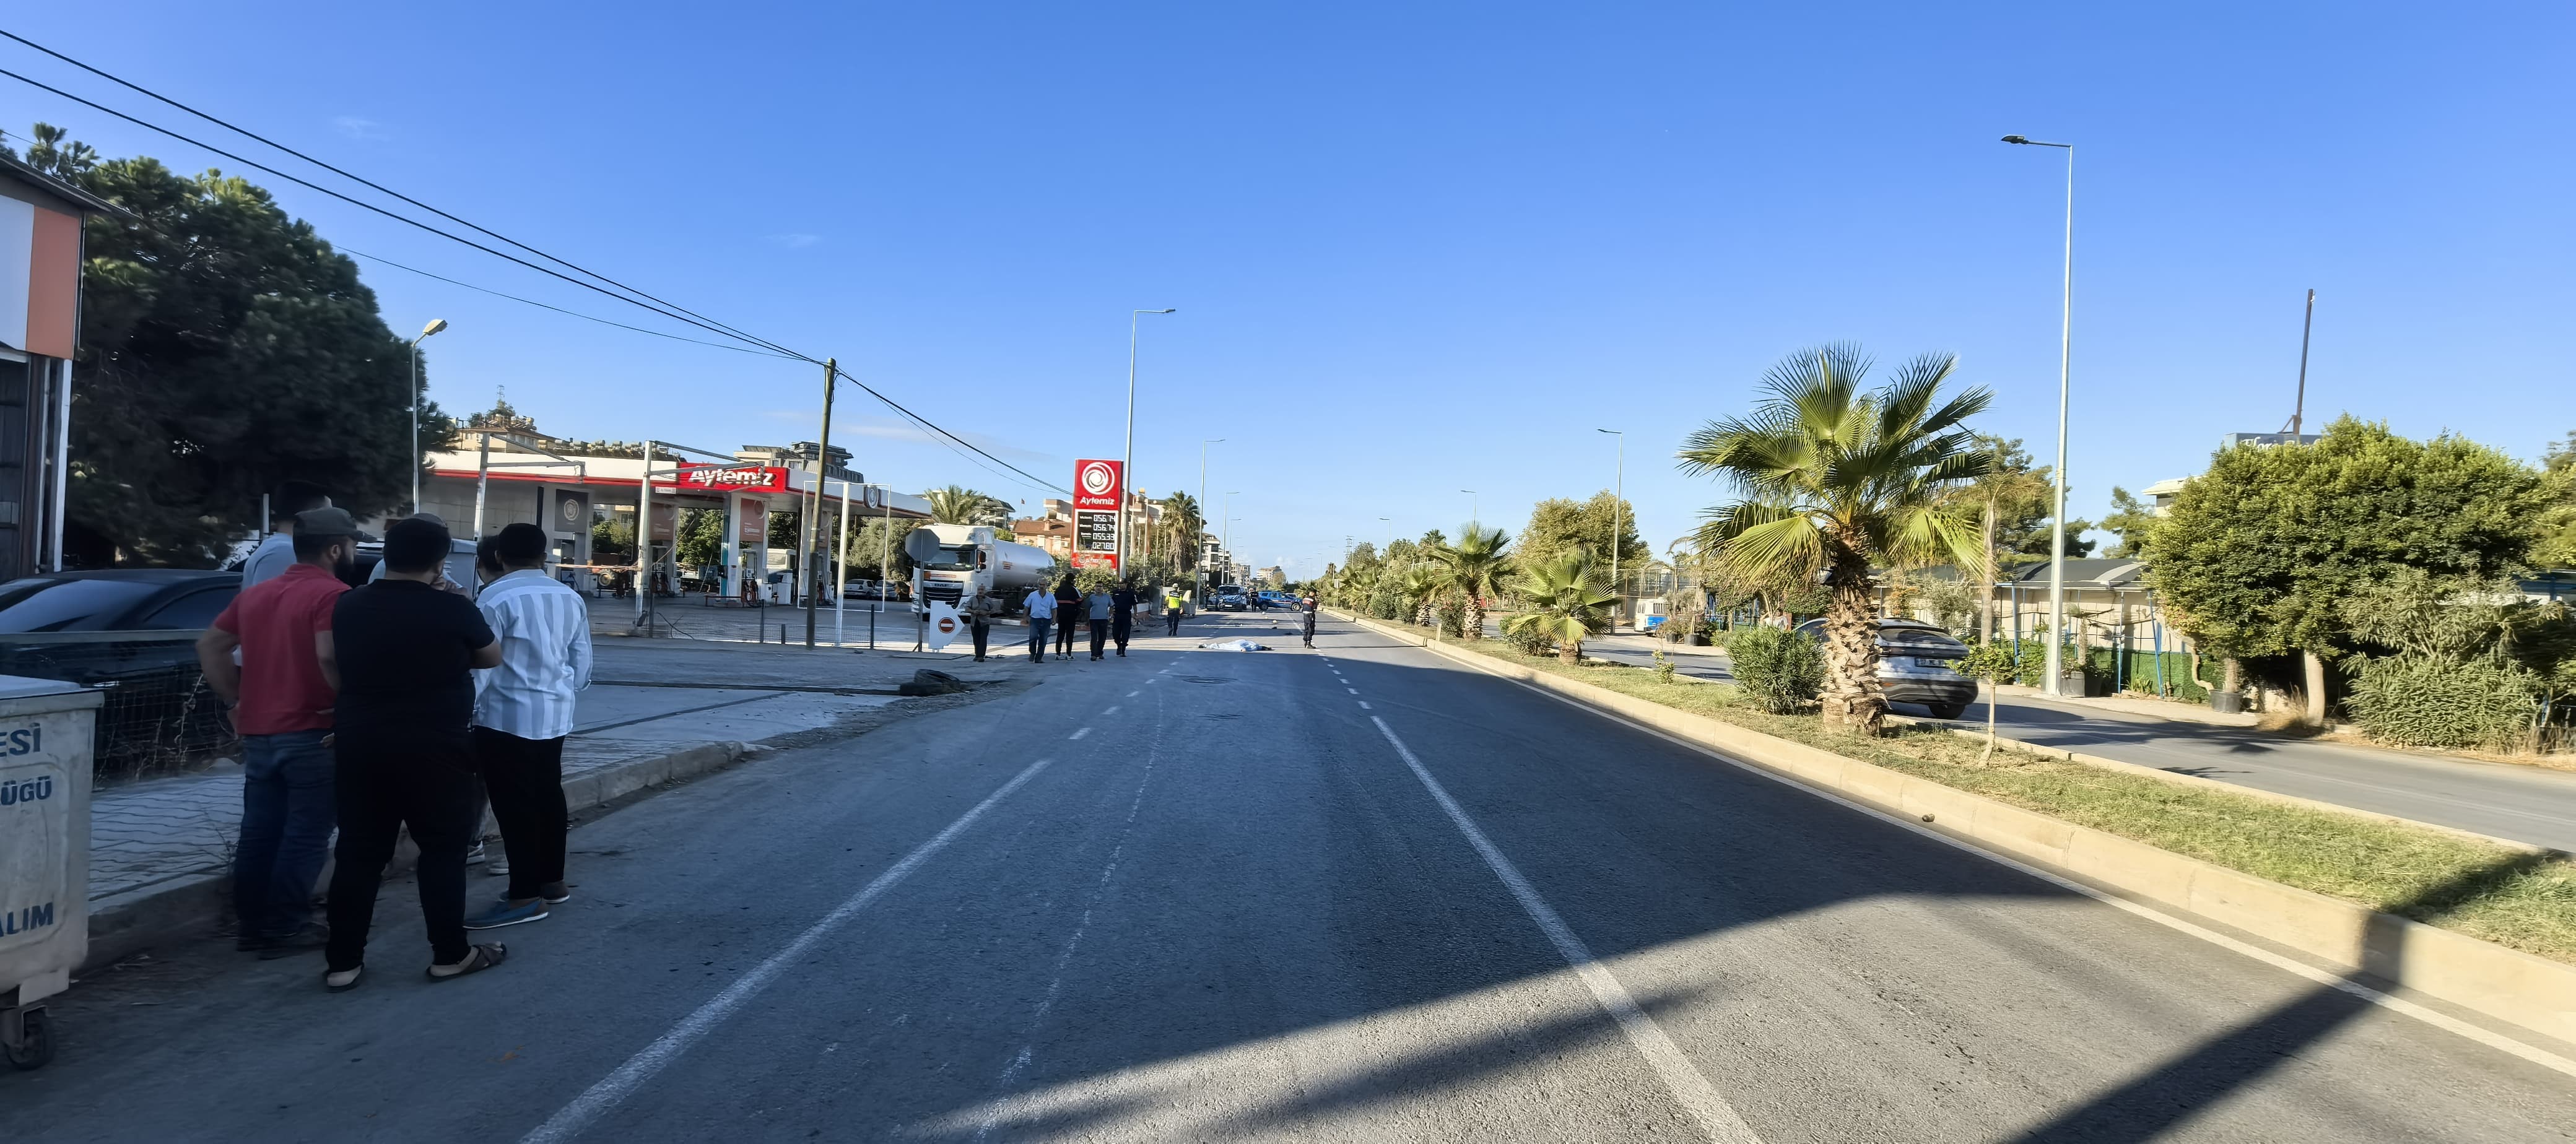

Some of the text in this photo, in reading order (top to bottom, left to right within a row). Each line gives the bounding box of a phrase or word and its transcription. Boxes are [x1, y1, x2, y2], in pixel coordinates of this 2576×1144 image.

[689, 469, 773, 487] Aytemiz
[1080, 496, 1115, 505] Aytemiz
[0, 901, 53, 937] LIM
